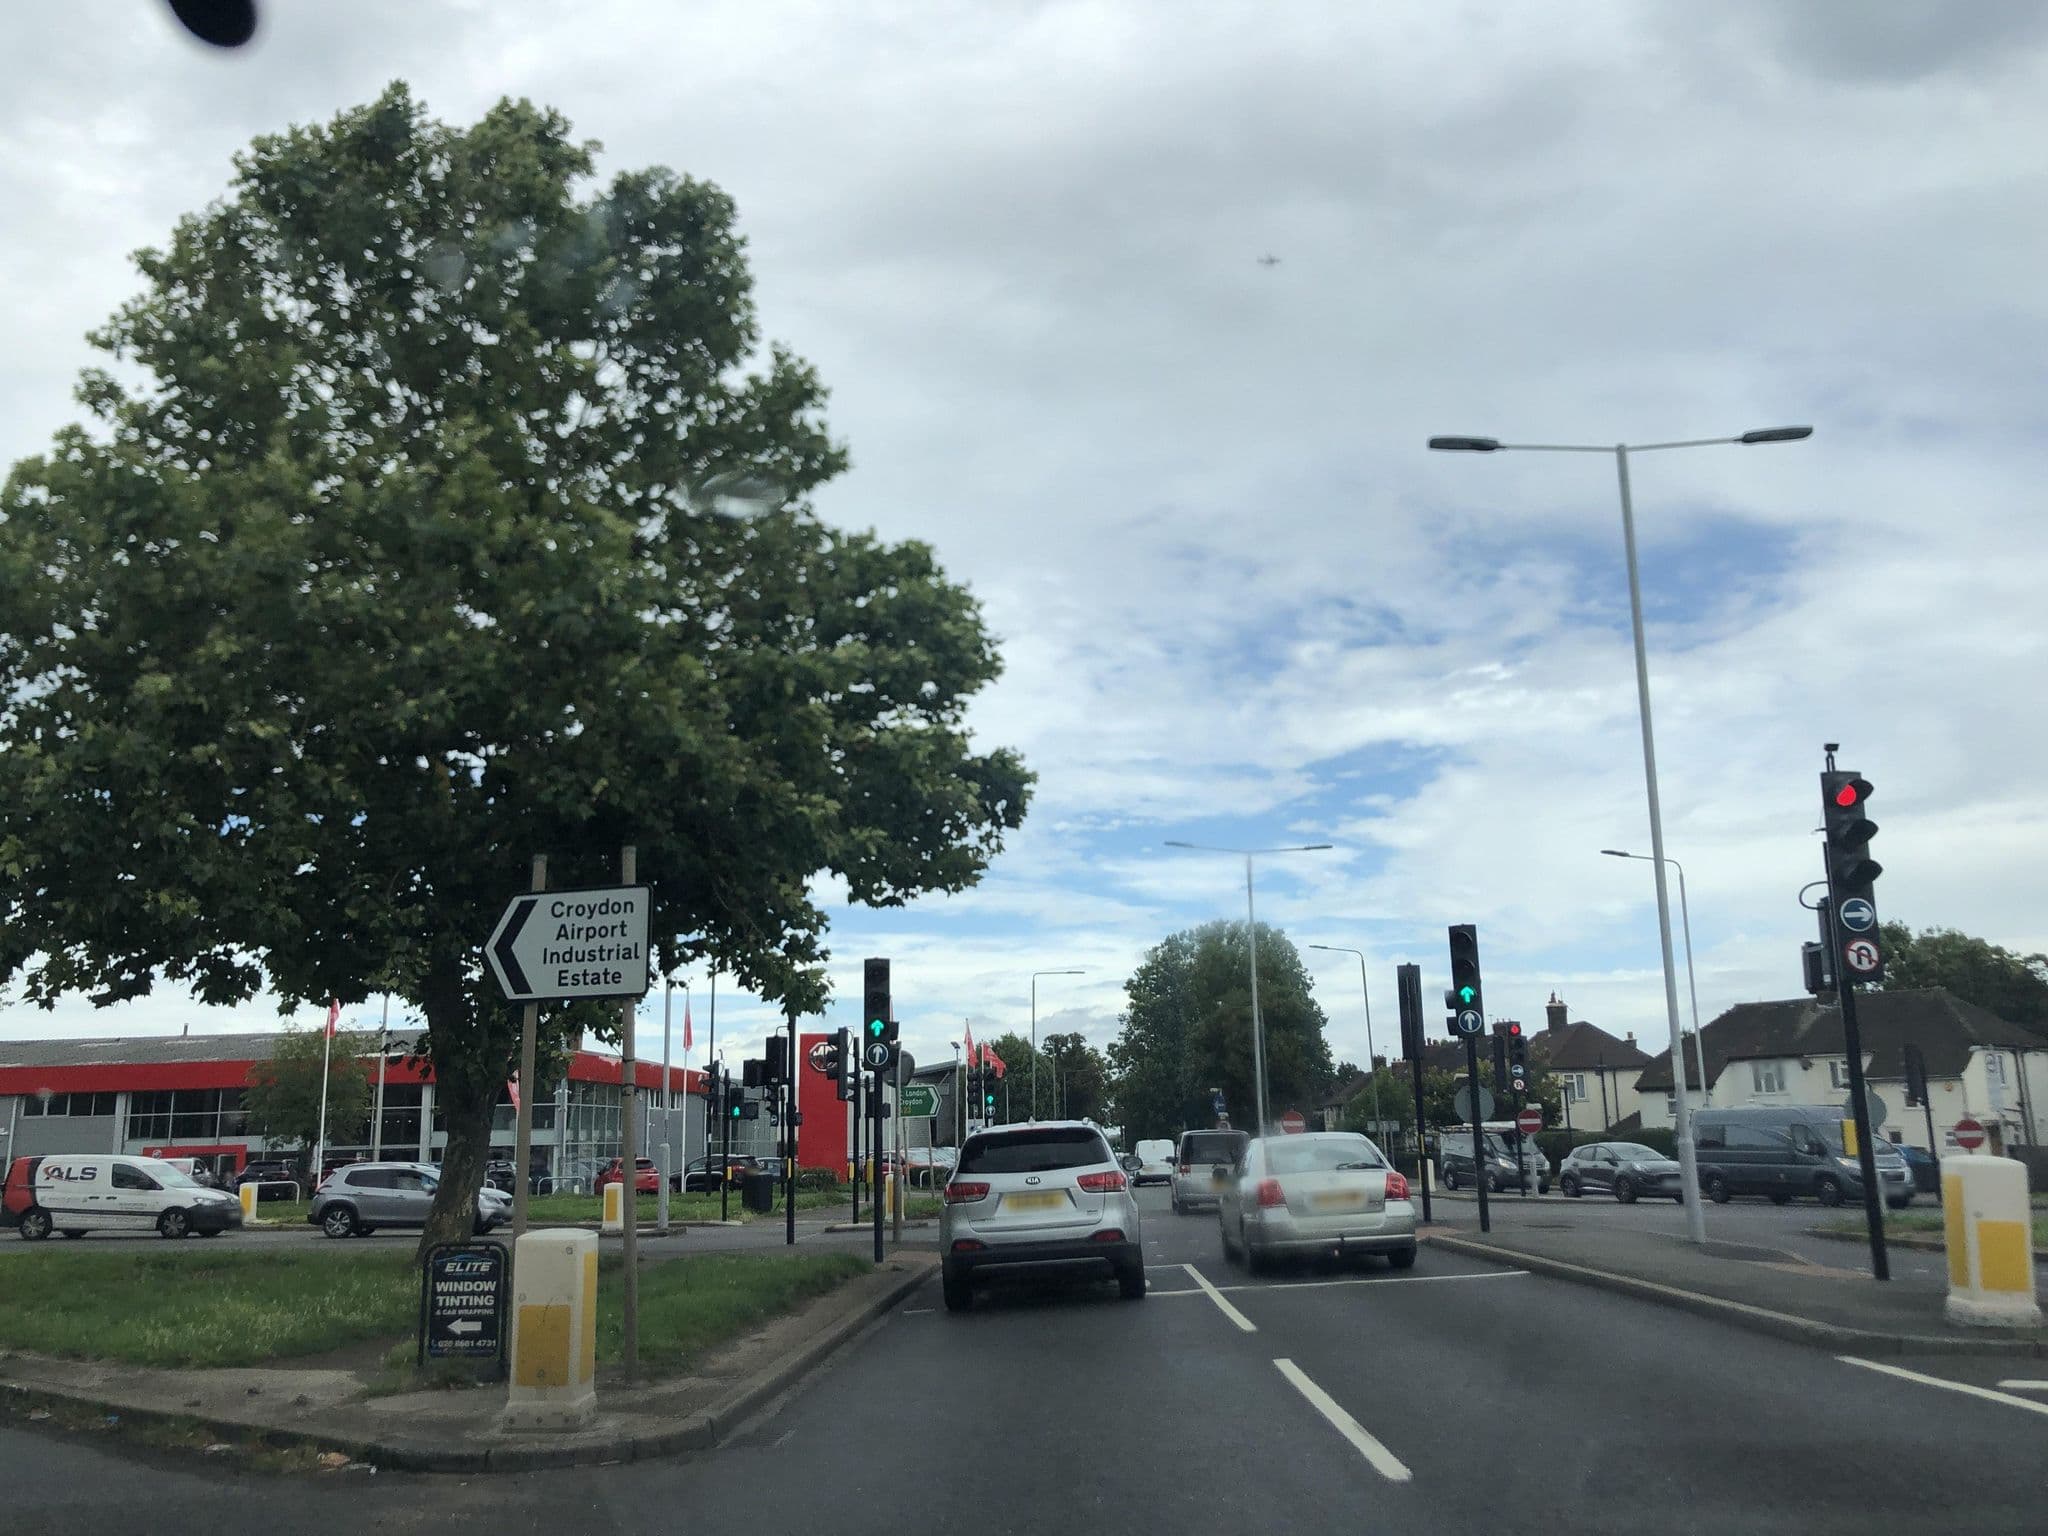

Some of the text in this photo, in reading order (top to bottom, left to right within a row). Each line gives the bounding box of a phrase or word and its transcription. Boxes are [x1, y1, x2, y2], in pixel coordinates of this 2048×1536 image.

[551, 898, 634, 919] Croydon
[555, 920, 628, 942] Airport
[543, 942, 640, 965] Industrial
[557, 968, 622, 987] Estate
[905, 1089, 928, 1097] London
[45, 1166, 98, 1181] ALS
[1026, 1176, 1040, 1184] KIA
[445, 1261, 493, 1272] ELITE
[436, 1281, 497, 1293] WINDOW
[436, 1295, 495, 1307] TINTING
